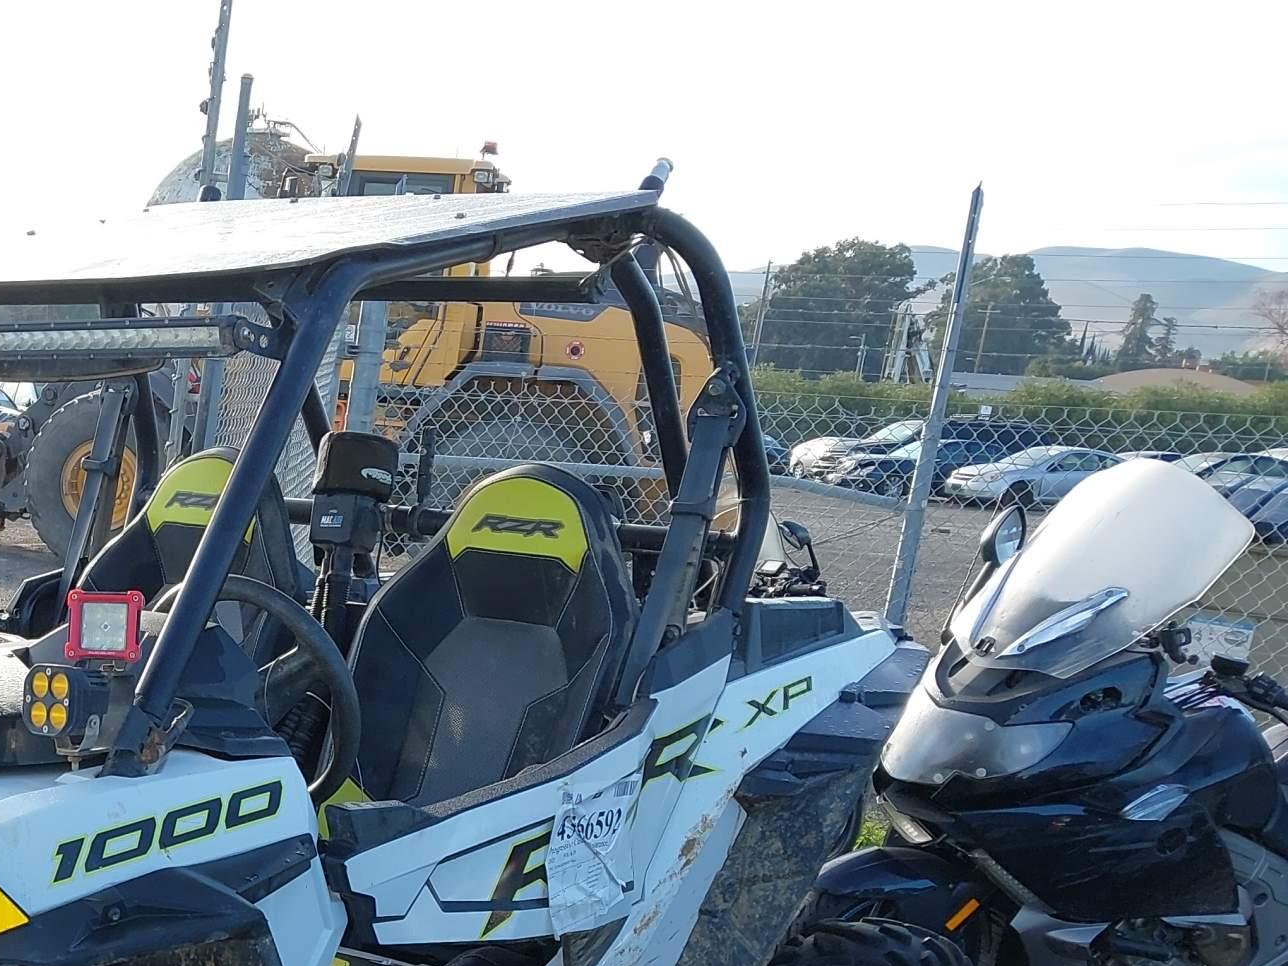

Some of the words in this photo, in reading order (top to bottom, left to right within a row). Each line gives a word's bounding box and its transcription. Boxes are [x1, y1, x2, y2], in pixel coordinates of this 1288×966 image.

[532, 302, 594, 316] VOLVO
[472, 514, 564, 539] RZR
[742, 676, 812, 730] XP
[51, 779, 284, 884] 1000
